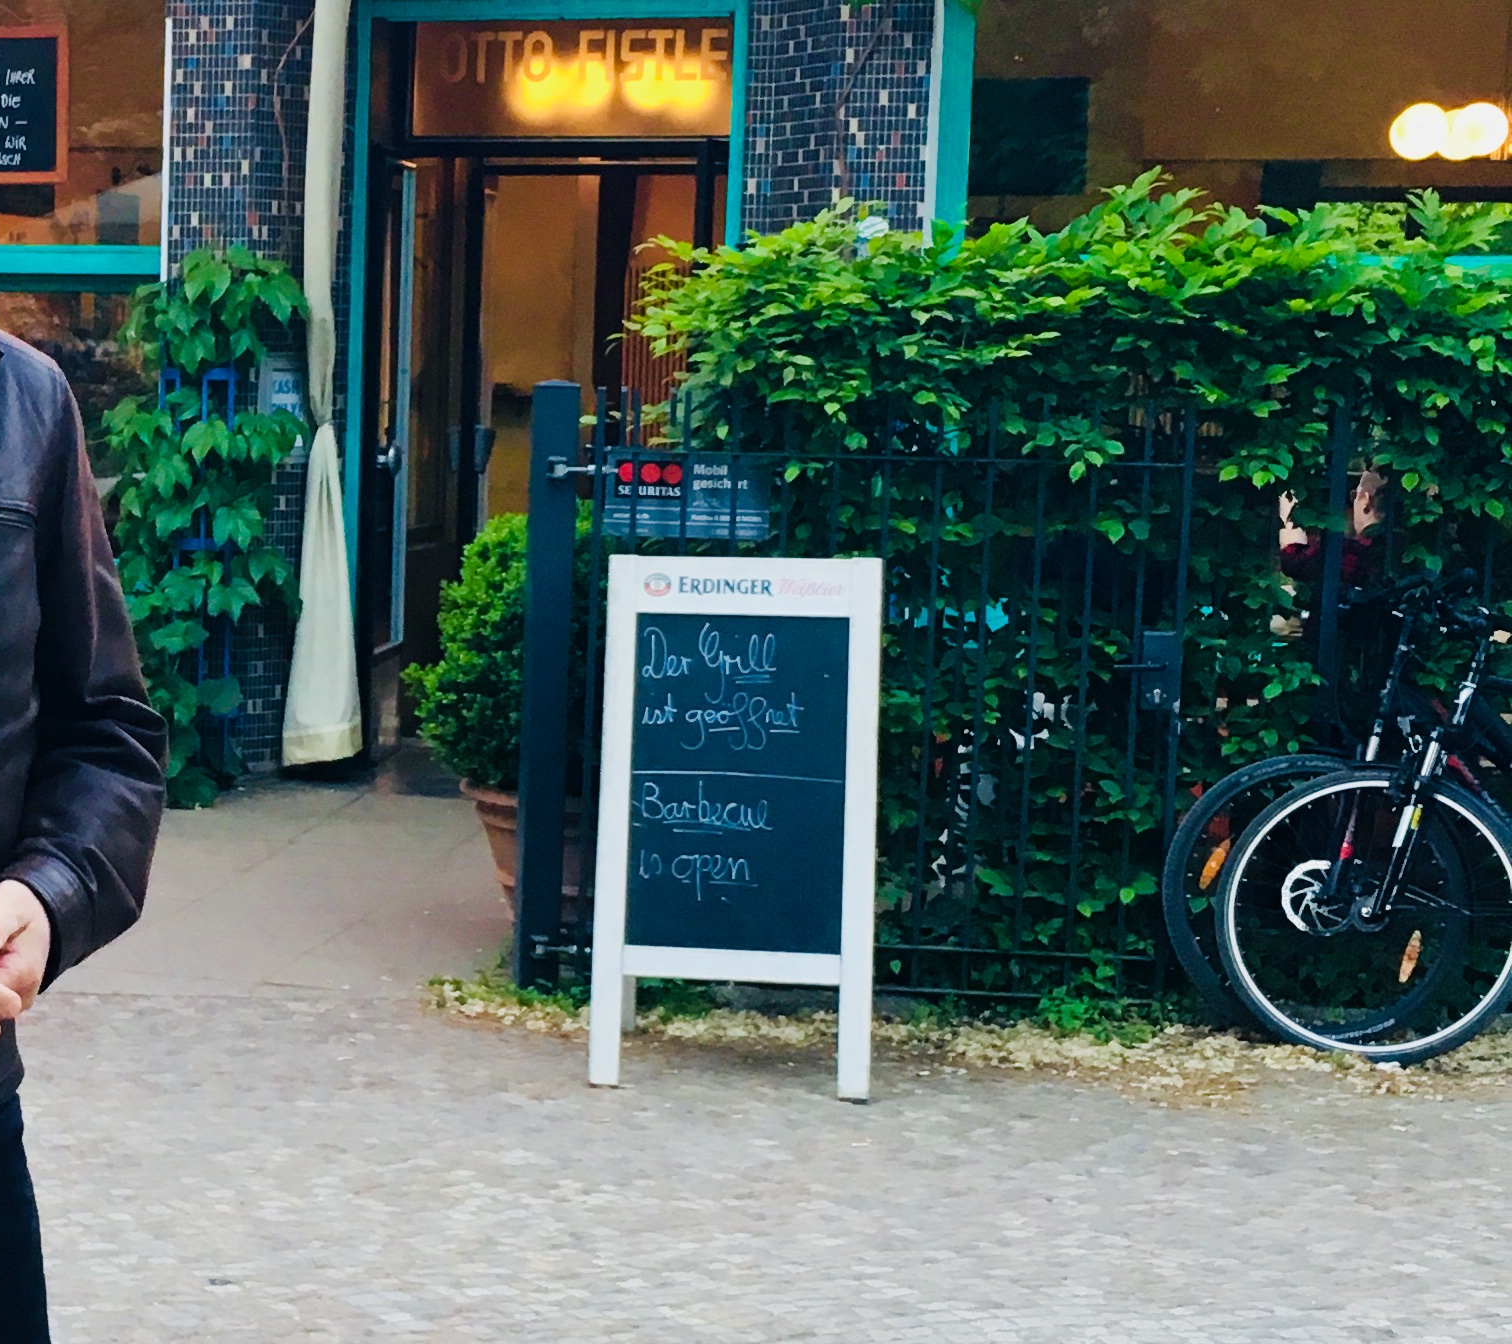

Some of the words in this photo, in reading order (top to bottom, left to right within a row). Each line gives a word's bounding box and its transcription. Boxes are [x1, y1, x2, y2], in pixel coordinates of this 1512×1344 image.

[440, 30, 554, 84] OTTO
[692, 478, 749, 491] gesichrt
[693, 464, 728, 476] Mobil
[617, 484, 681, 497] SEURITAS
[678, 575, 774, 597] ERDINGER
[642, 626, 692, 679] Der
[698, 622, 777, 704] Grill
[642, 693, 678, 725] ist
[641, 780, 774, 831] Barbecue
[671, 854, 751, 902] open
